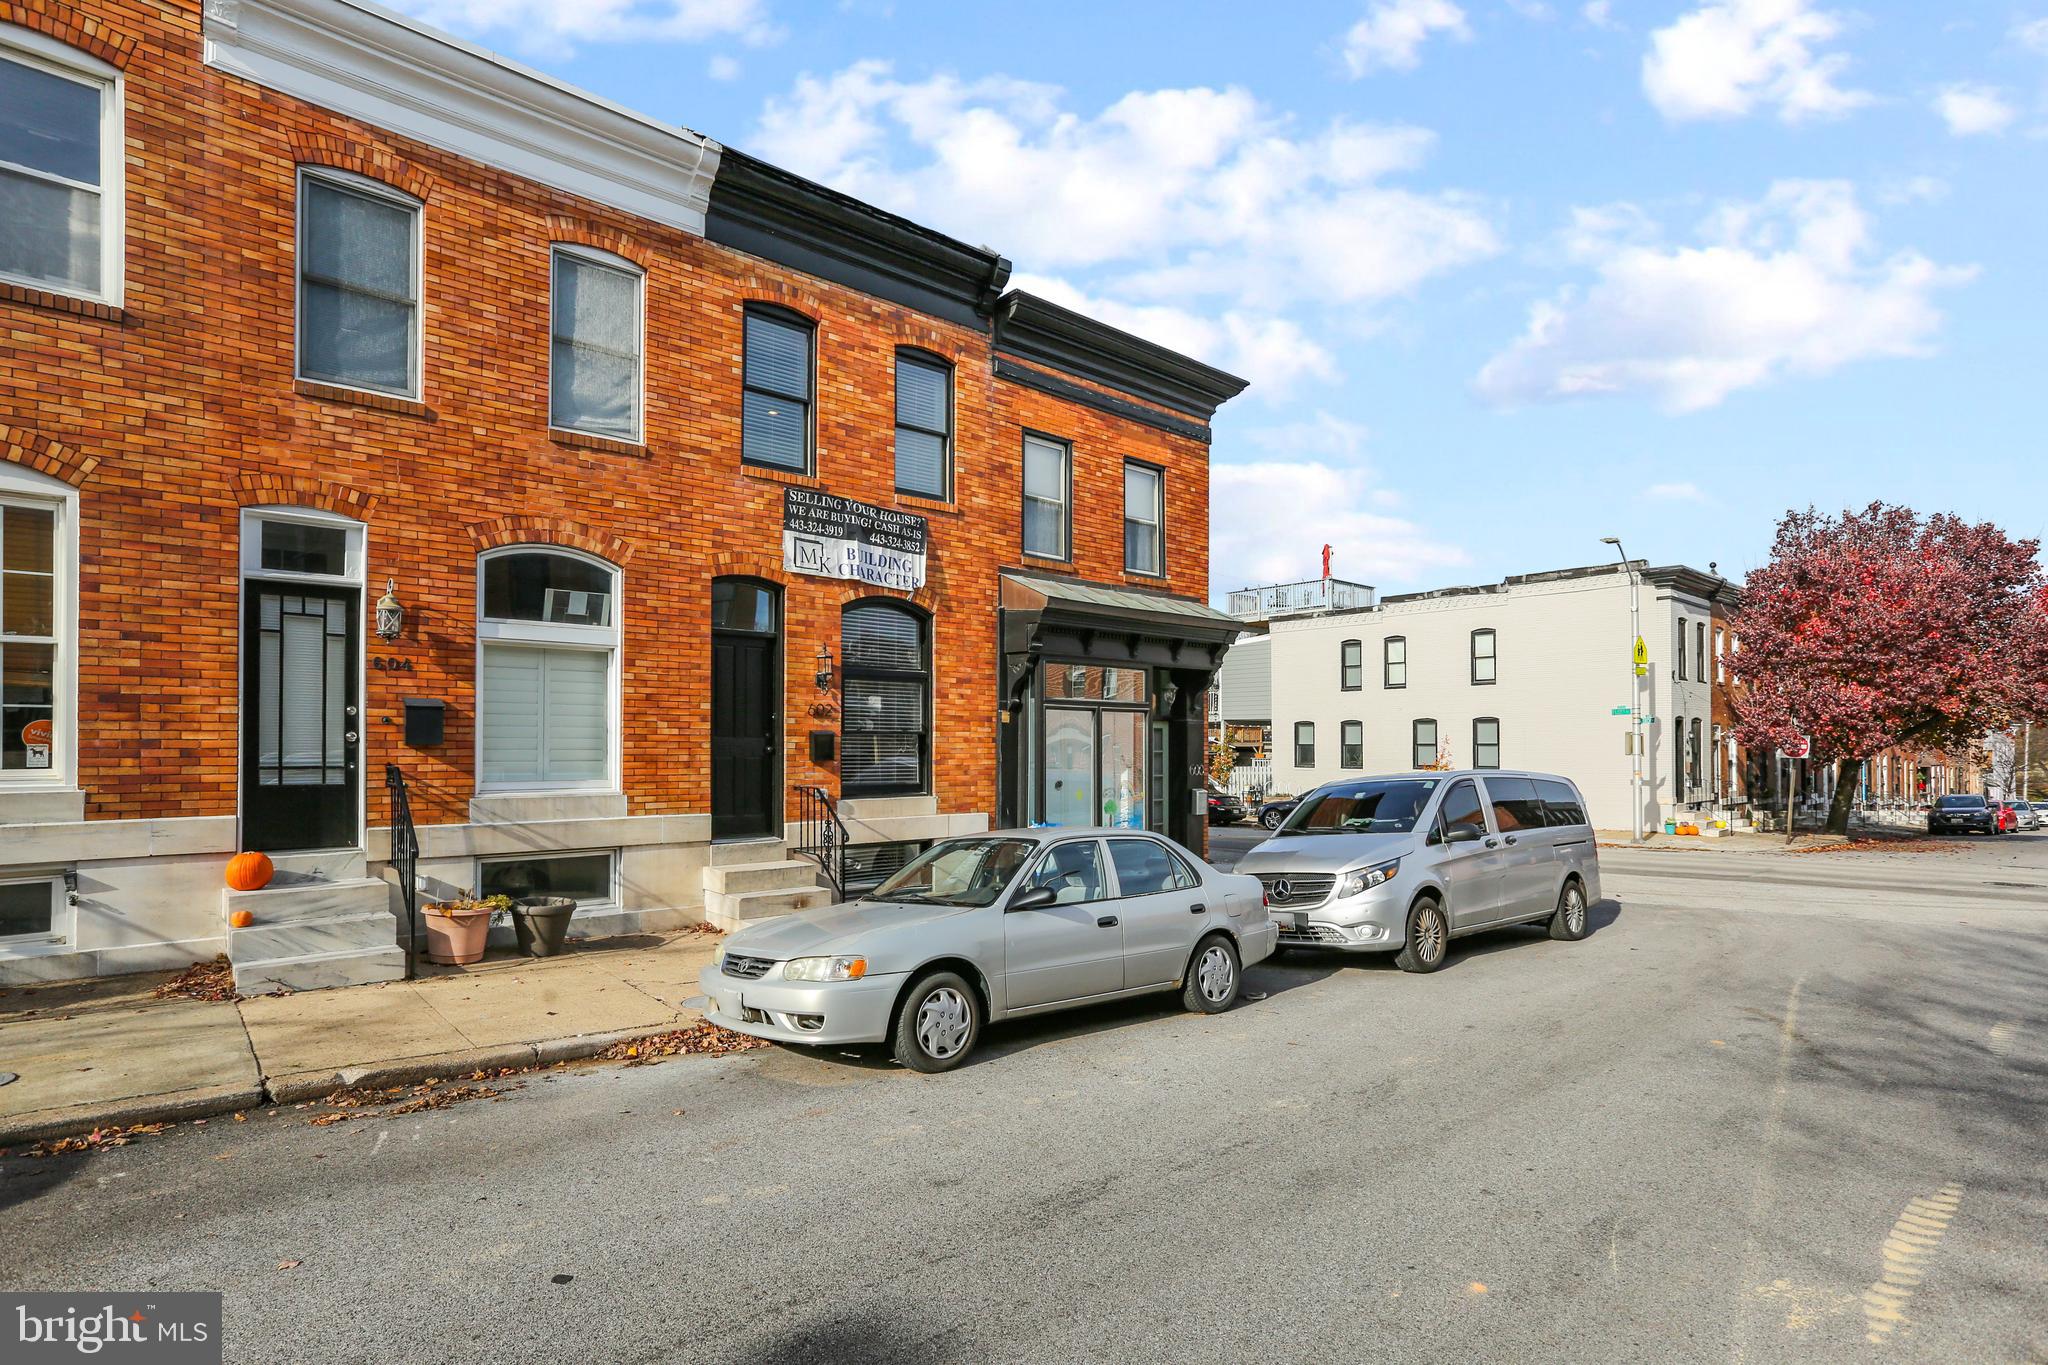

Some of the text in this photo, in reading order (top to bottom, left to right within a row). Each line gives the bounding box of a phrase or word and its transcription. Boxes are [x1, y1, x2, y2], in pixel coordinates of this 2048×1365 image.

[788, 504, 922, 539] WE ARE BUYING! CASH AS-IS
[789, 491, 921, 527] SELLING YOUR HOUSE?
[789, 518, 843, 537] 443-324-3919
[870, 533, 920, 552] 443-324-3852
[847, 548, 912, 573] BUILDING
[839, 563, 920, 588] CHARACTER
[373, 657, 412, 671] 604
